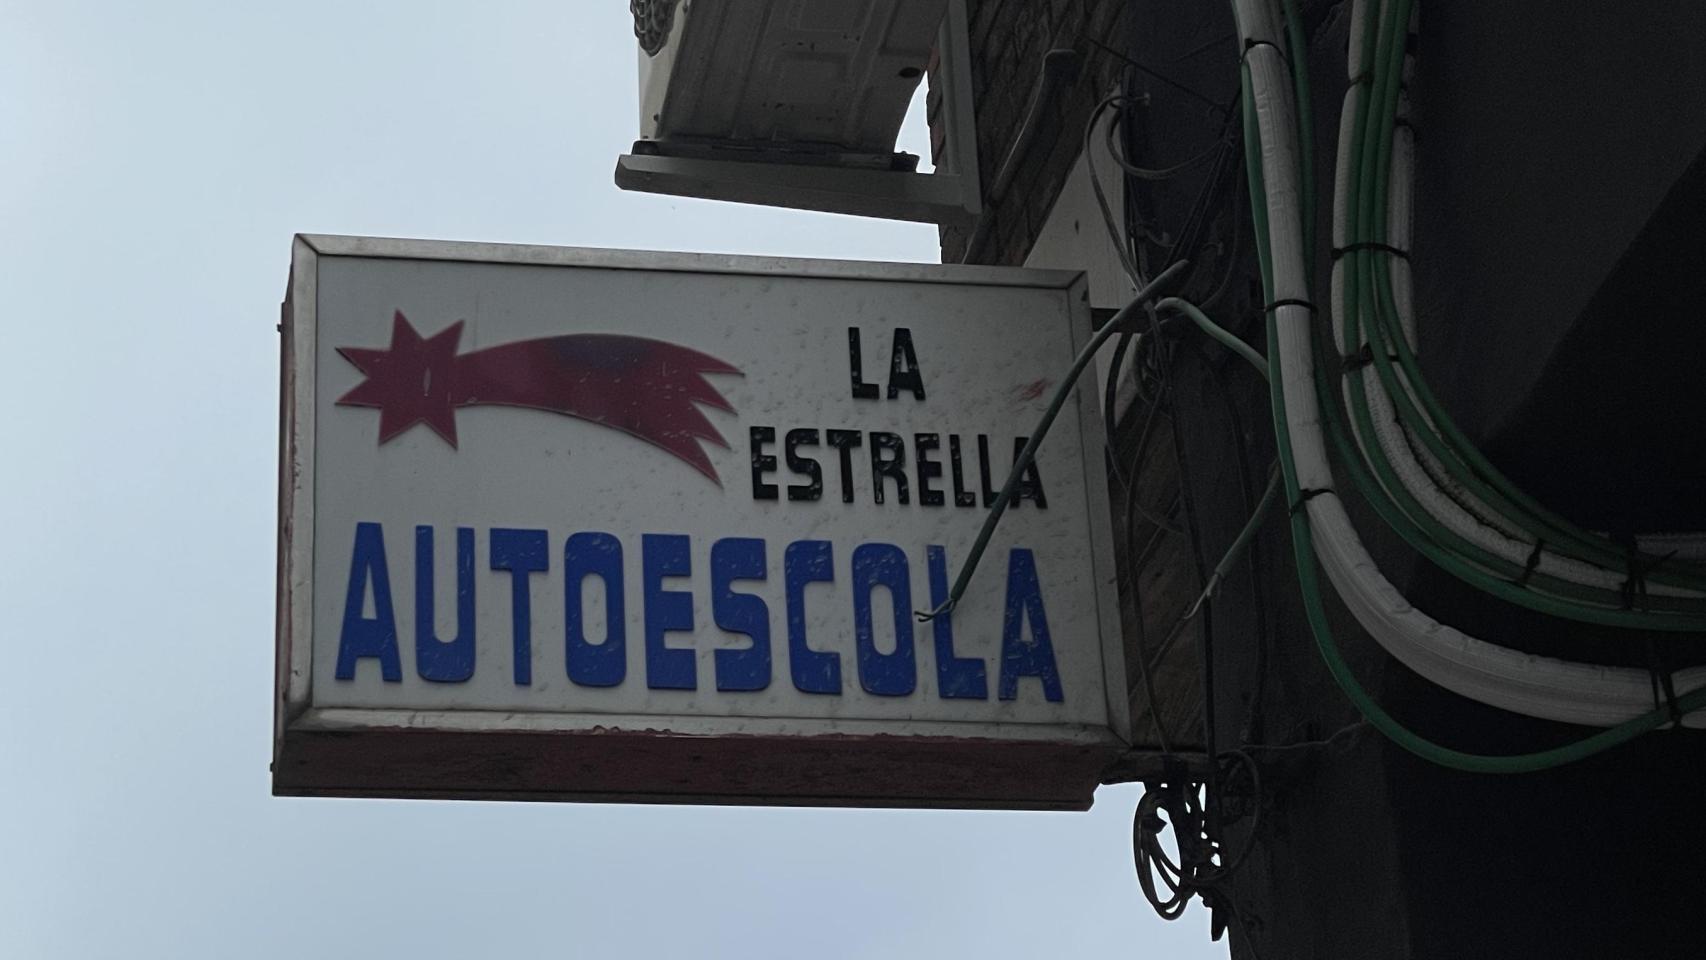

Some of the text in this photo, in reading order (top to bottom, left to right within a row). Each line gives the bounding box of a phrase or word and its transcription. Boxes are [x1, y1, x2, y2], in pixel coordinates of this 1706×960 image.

[848, 327, 926, 400] LA
[750, 426, 1048, 509] ESTRELLA
[335, 522, 1064, 702] AUTOESCOLA
